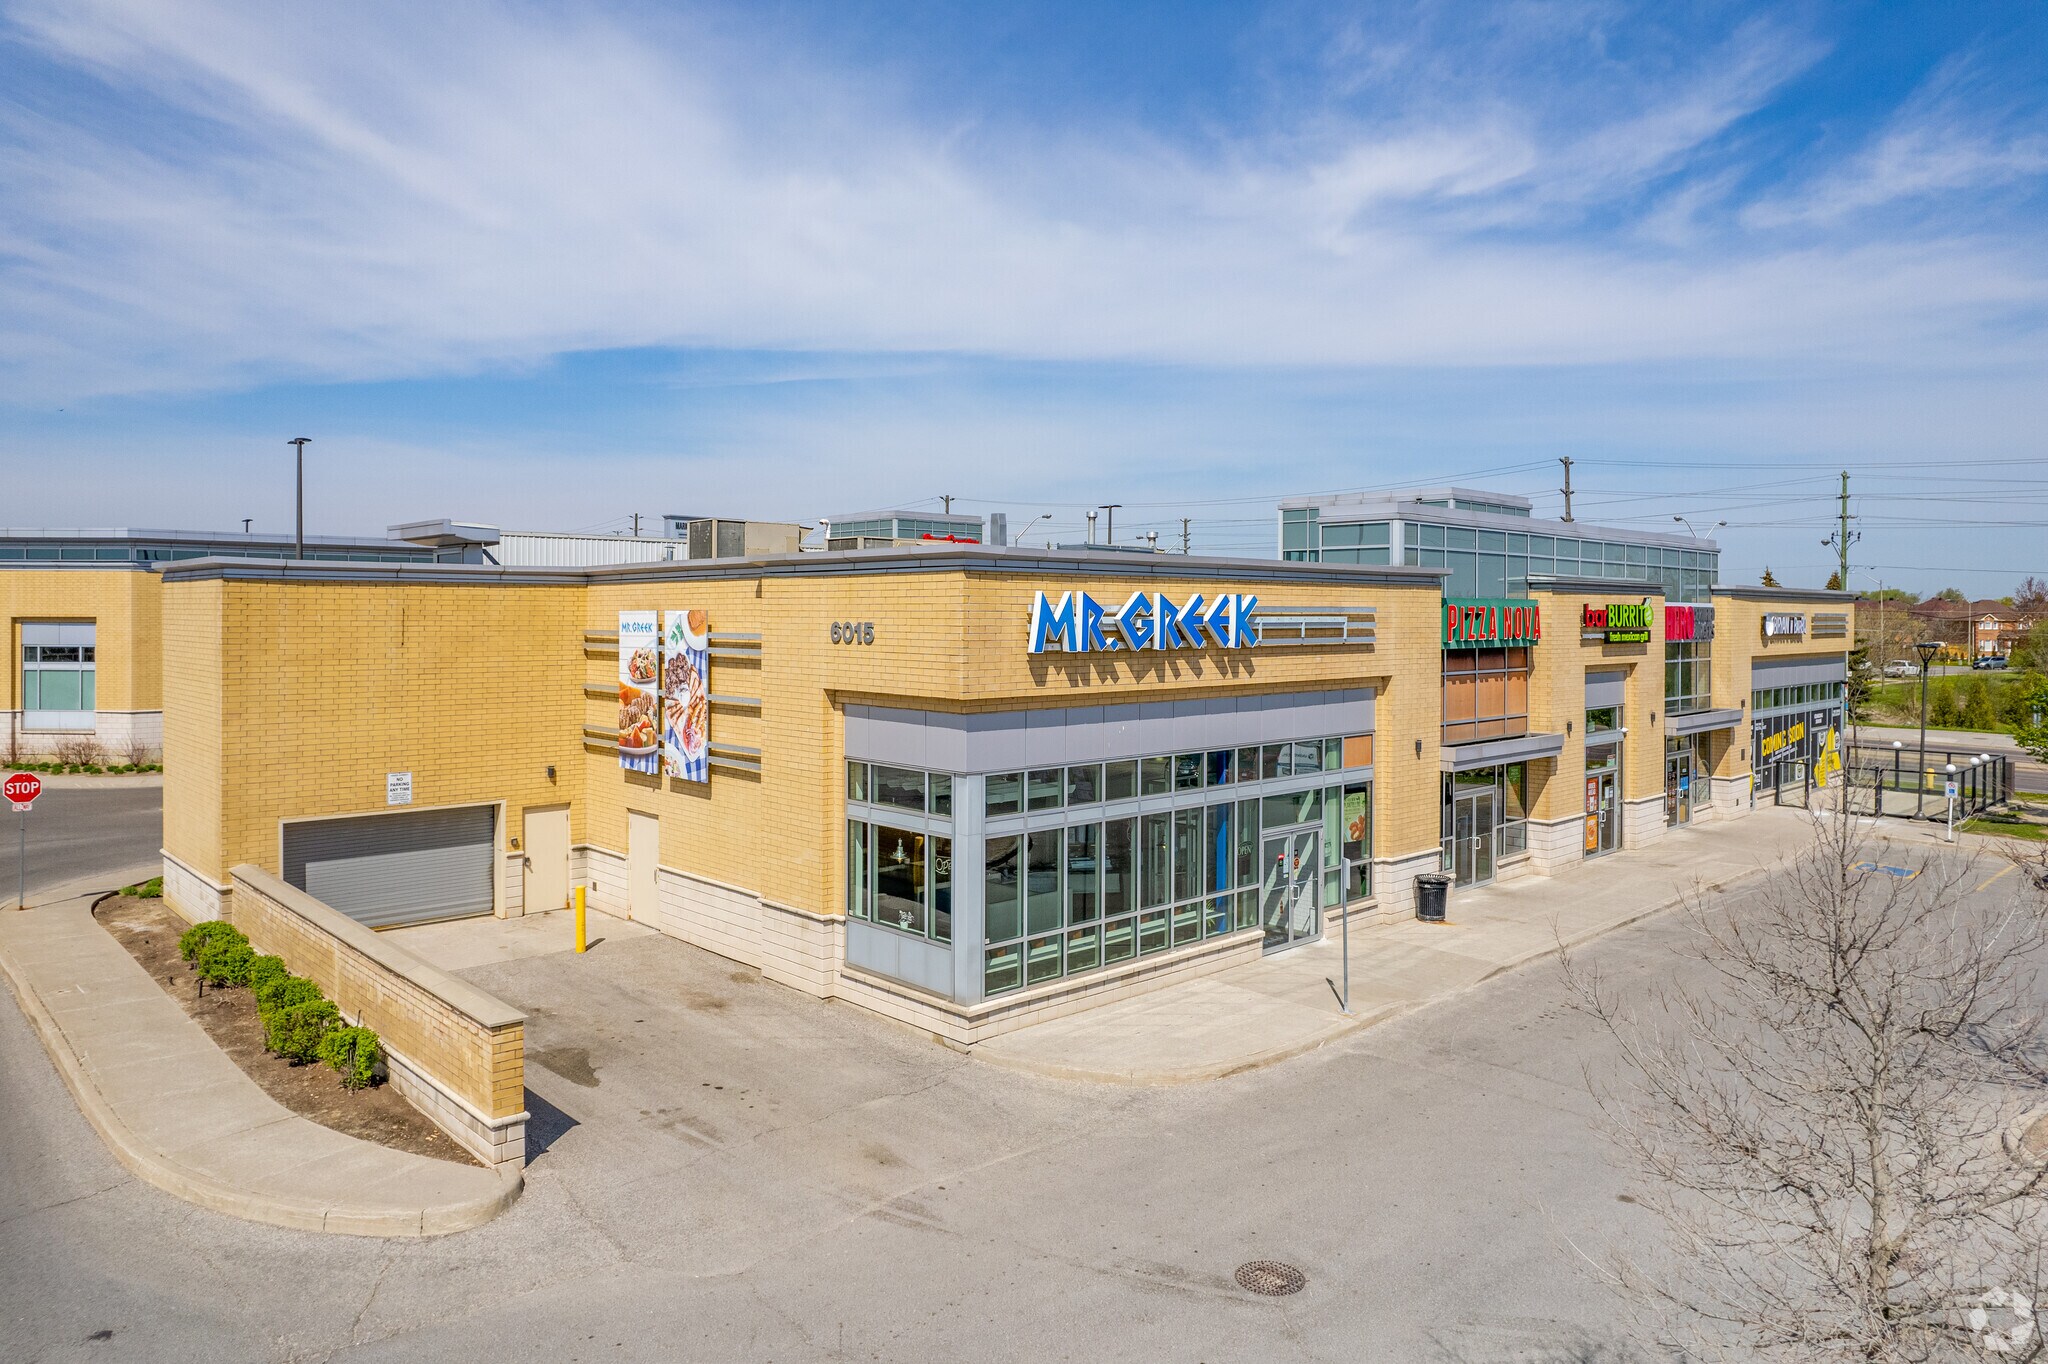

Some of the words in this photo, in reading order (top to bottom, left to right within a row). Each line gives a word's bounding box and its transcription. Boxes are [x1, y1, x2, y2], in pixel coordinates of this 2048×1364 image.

[831, 621, 875, 645] 6015
[1447, 604, 1498, 643] PIZZA
[1503, 605, 1541, 640] NOVA
[1762, 730, 1787, 757] COMING
[1789, 721, 1805, 744] SOON
[6, 782, 39, 794] STOP
